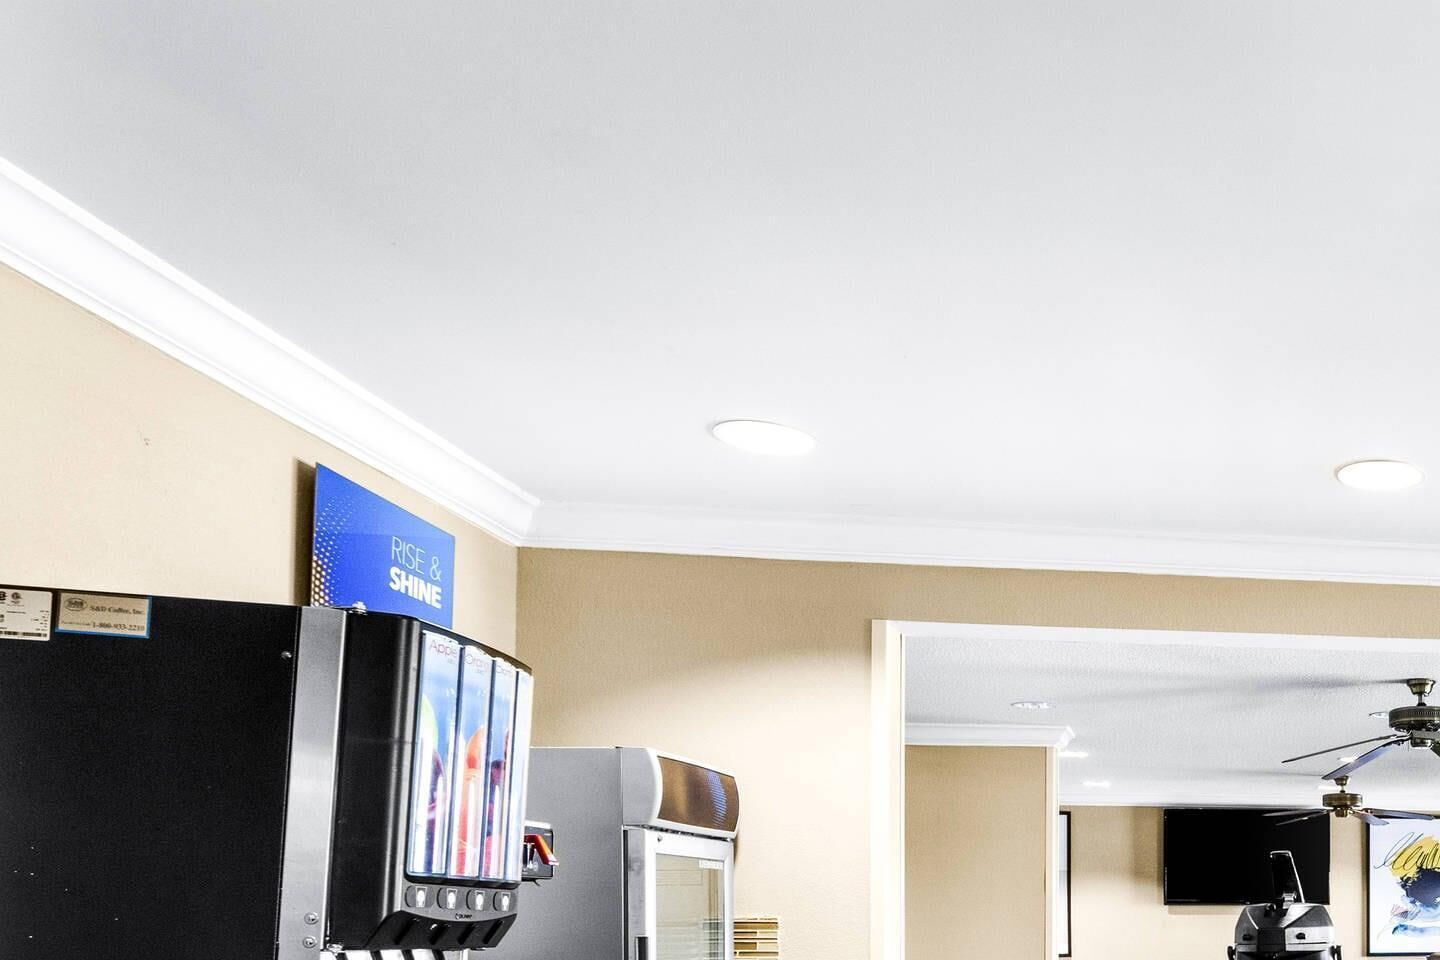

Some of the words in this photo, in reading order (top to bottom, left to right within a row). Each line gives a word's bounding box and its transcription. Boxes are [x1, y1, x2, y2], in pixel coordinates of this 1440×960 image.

[392, 536, 425, 575] RISE
[430, 556, 442, 581] &
[389, 566, 442, 609] SHINE
